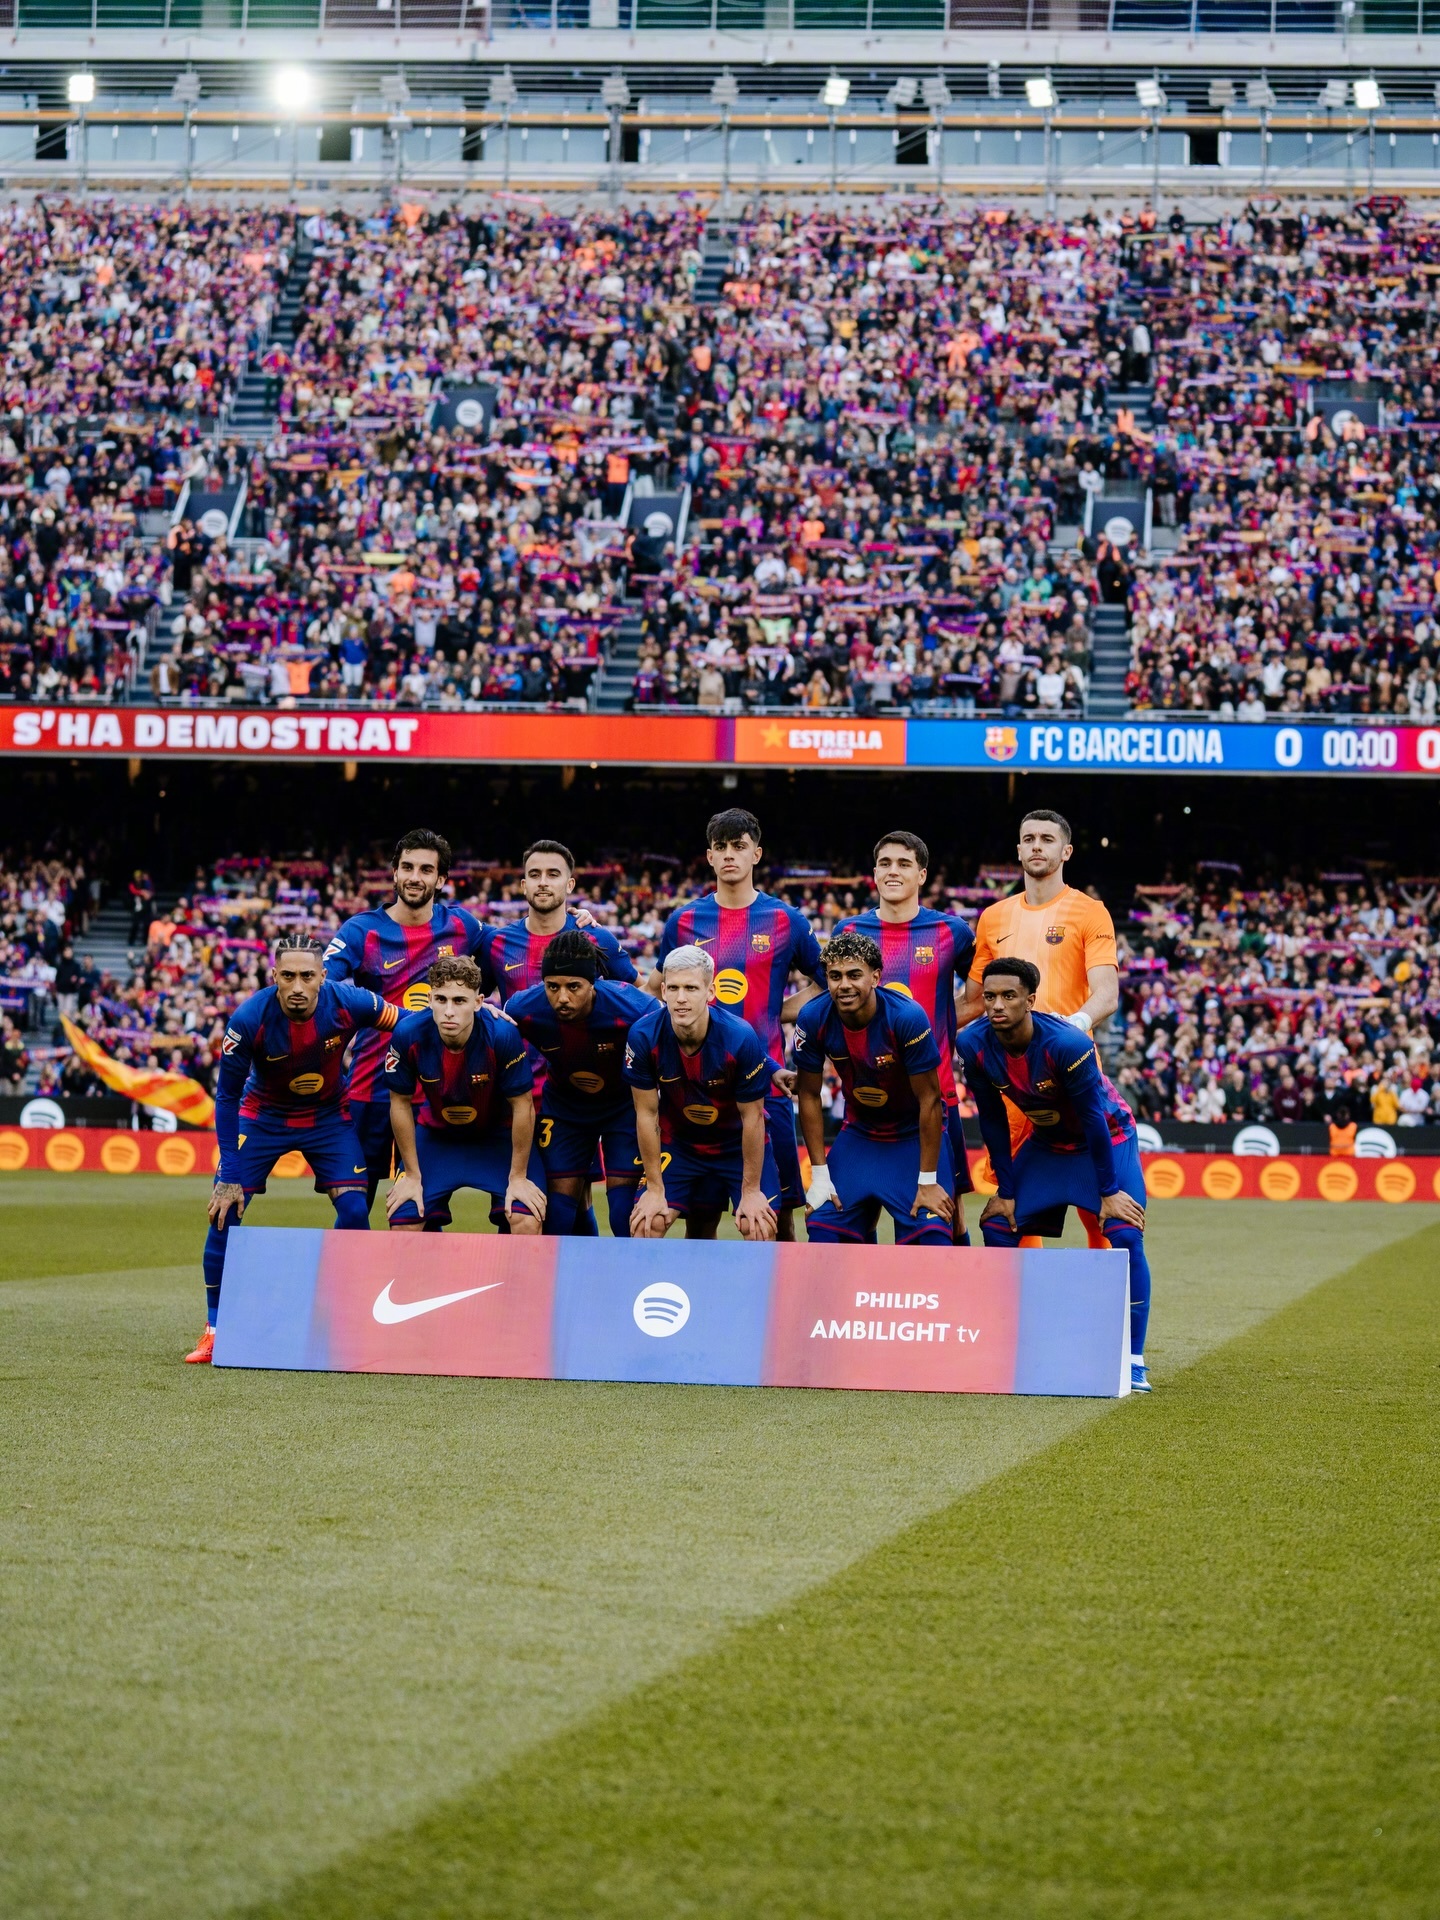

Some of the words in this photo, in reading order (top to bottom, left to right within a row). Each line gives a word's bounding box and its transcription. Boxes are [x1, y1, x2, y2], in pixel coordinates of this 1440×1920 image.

[12, 711, 122, 747] S'HA
[134, 714, 418, 751] DEMOSTRAT
[789, 729, 882, 750] ESTRELLA
[1030, 726, 1063, 761] FC
[1068, 727, 1224, 764] BARCELONA
[1275, 728, 1303, 767] 0
[1322, 730, 1398, 767] 00:00
[855, 1291, 940, 1310] PHILIPS
[810, 1319, 950, 1342] AMBILIGHT
[957, 1326, 980, 1343] tv
